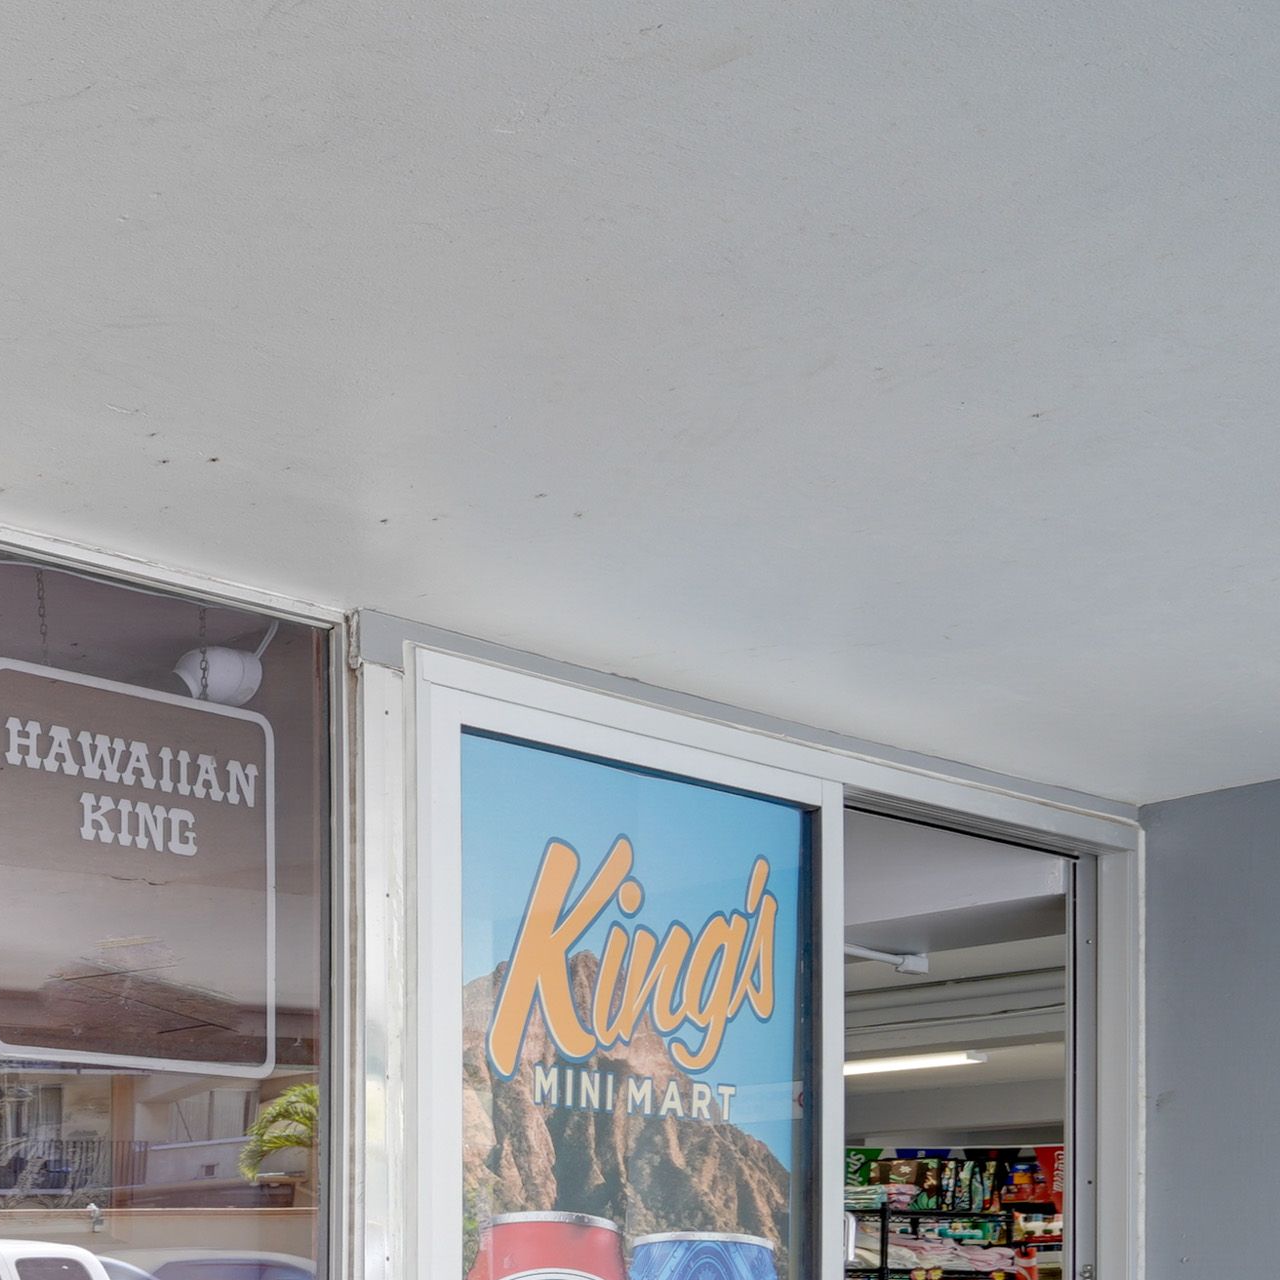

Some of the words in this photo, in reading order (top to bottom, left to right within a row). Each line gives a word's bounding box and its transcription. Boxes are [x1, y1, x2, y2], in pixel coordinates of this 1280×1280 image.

[5, 716, 259, 808] HAWAIIAN
[79, 792, 198, 857] KING
[486, 833, 778, 1081] King's
[534, 1064, 614, 1112] MINI
[627, 1077, 737, 1122] MART
